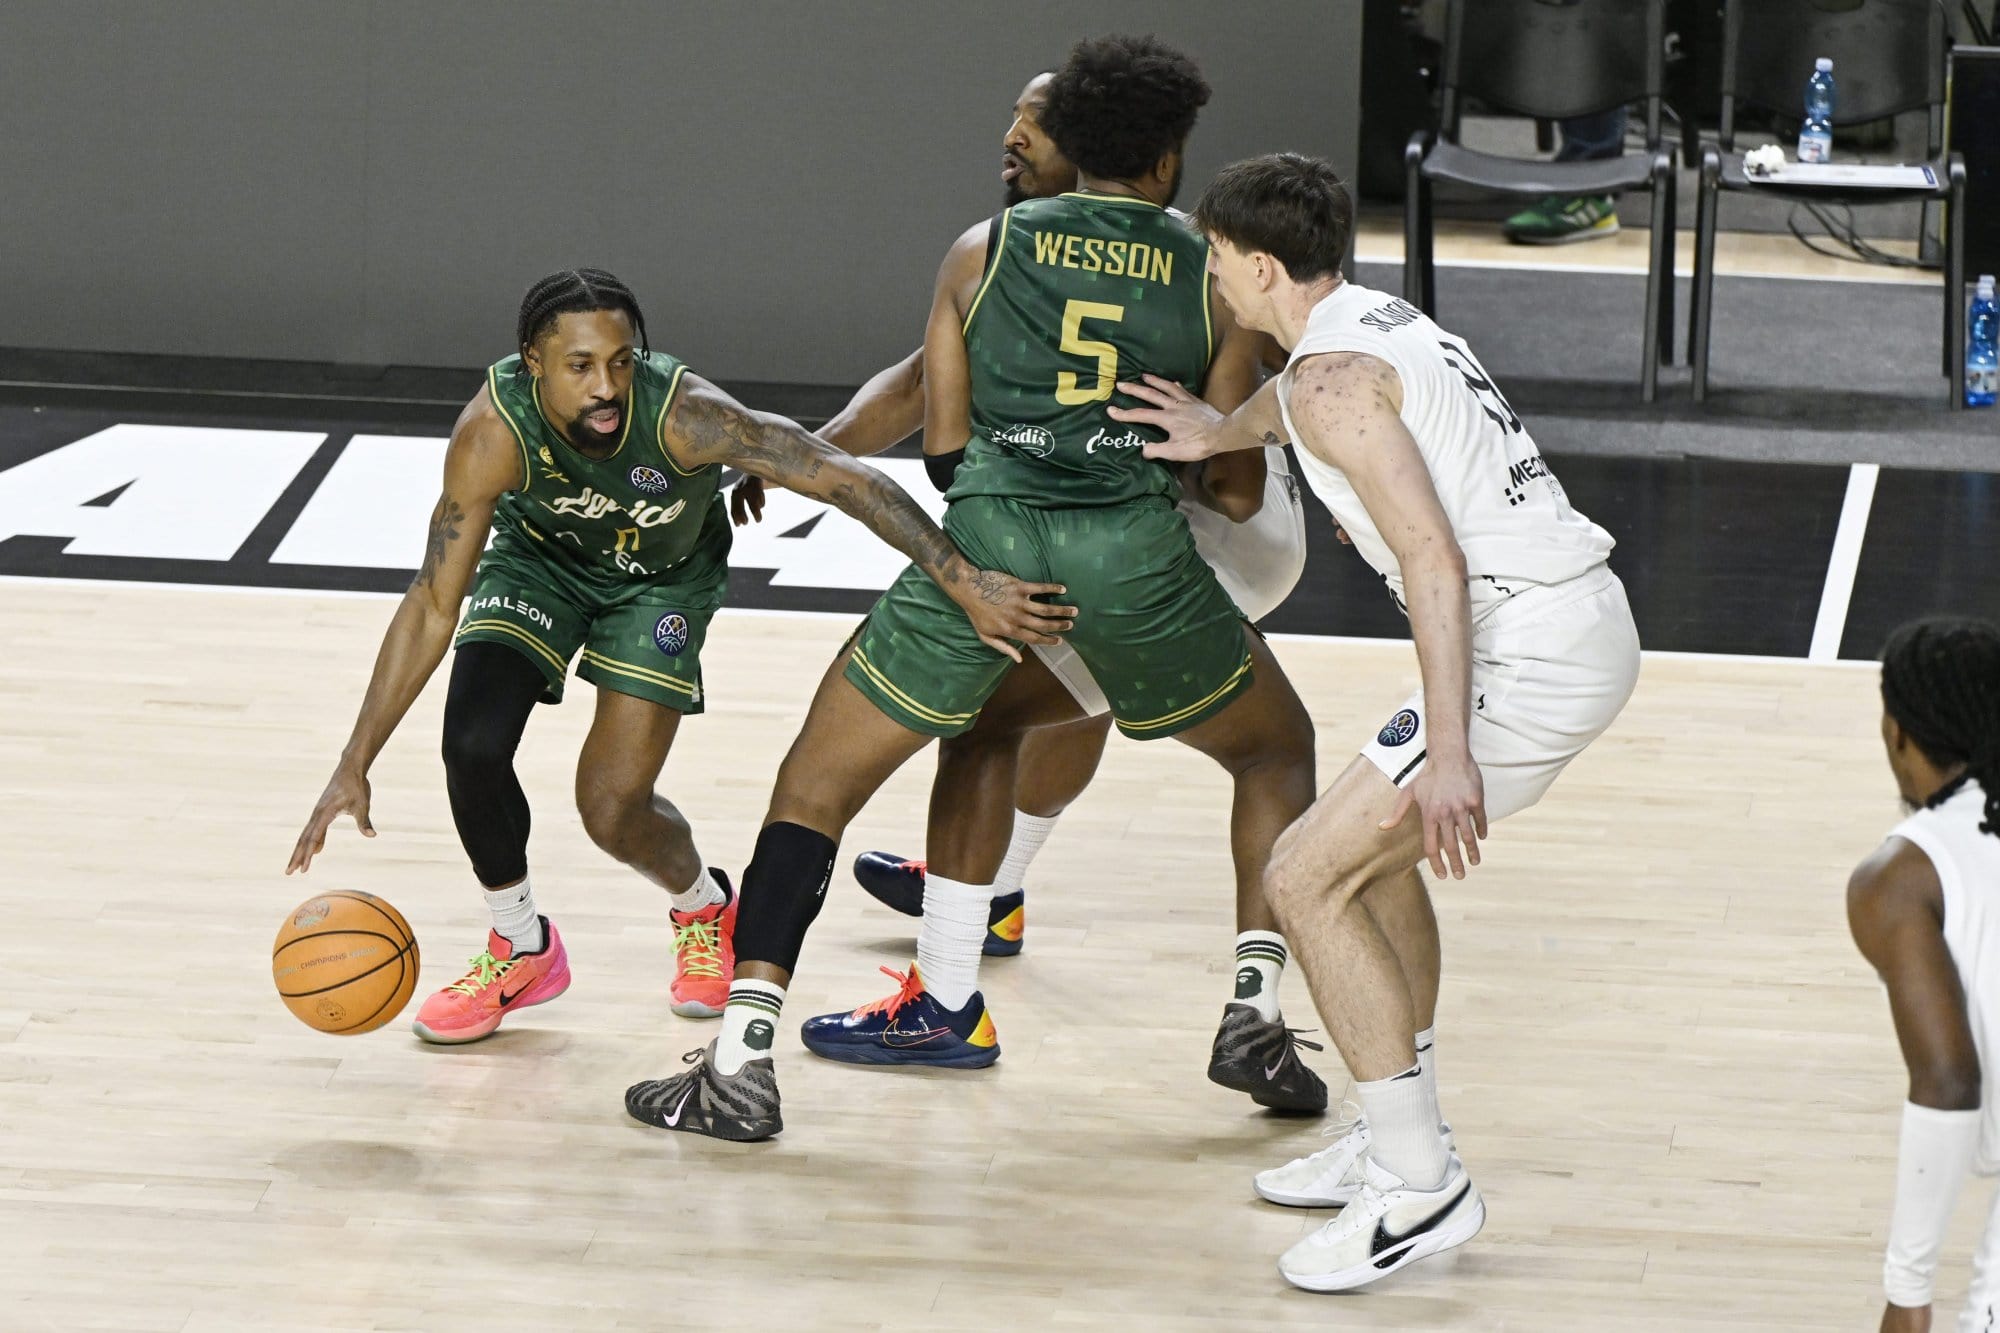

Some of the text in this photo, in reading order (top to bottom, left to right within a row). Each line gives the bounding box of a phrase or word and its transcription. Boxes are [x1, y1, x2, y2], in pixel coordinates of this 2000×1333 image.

[1034, 231, 1173, 286] WESSON
[1055, 299, 1125, 406] 5
[473, 596, 553, 631] HALEON
